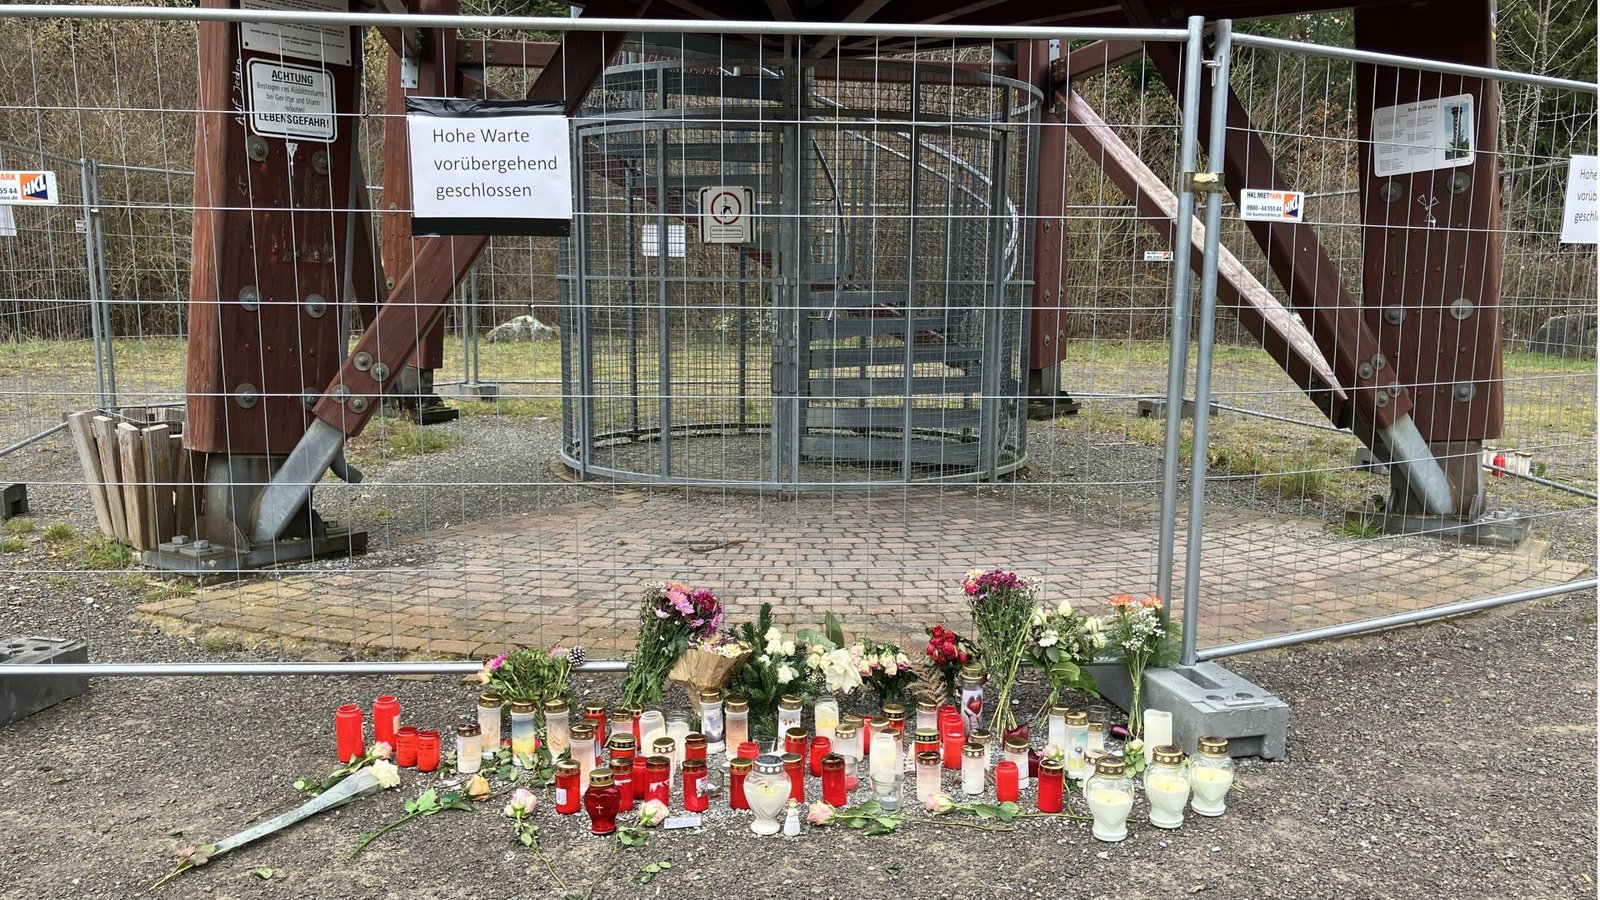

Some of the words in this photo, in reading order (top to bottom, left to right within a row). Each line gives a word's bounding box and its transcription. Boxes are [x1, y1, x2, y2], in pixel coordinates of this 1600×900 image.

[272, 70, 314, 84] ACHTUNG
[306, 98, 320, 106] Sturm
[259, 113, 330, 128] LEBENSGEFAHR!
[433, 128, 475, 143] Hohe
[480, 128, 530, 143] Warte
[433, 155, 558, 174] vorübergehend
[1579, 168, 1598, 180] Hohe
[23, 174, 48, 196] HKL
[436, 182, 532, 201] geschlossen
[1285, 194, 1299, 214] HKL
